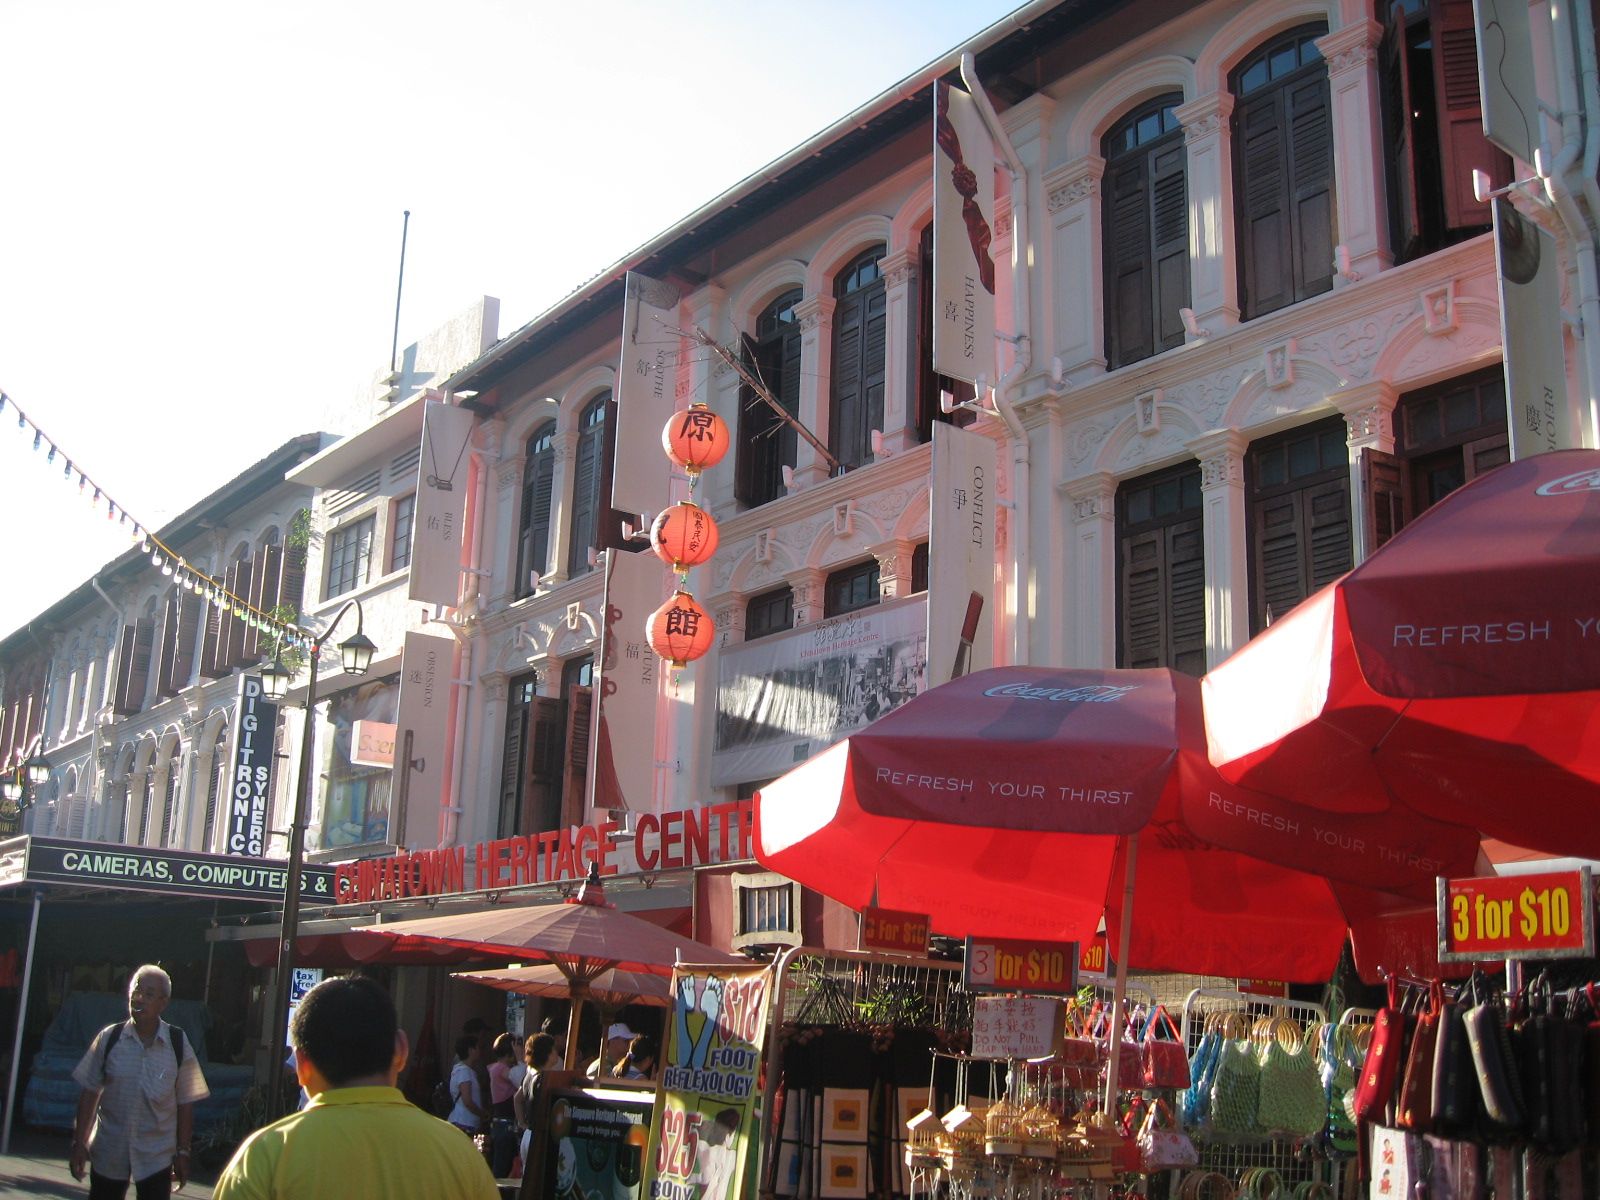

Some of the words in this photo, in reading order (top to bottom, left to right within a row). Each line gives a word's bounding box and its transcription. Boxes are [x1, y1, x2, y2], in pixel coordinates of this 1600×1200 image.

[964, 274, 975, 359] HAPPINESS
[654, 349, 665, 399] SOOTHE
[680, 410, 717, 442] 原
[972, 465, 984, 549] CONFLICT
[443, 512, 453, 541] BLESS
[665, 606, 701, 638] 館
[1393, 620, 1550, 647] REFRESH
[832, 639, 858, 651] Heritage
[858, 632, 881, 645] Centre
[423, 650, 437, 708] OBSESSION
[982, 682, 1142, 703] Coca-Cola
[231, 680, 261, 856] DIGITRONIC
[876, 767, 973, 793] REFRESH
[988, 781, 1045, 799] YOUR
[1059, 787, 1134, 805] THIRST
[248, 765, 268, 856] SYNERG
[1209, 791, 1300, 836] REFRESH
[1312, 827, 1366, 854] YOUR
[1377, 845, 1443, 873] THIRST
[62, 852, 174, 883] CAMERAS,
[314, 876, 328, 893] &
[334, 845, 465, 905] CHINATOWN
[475, 821, 618, 890] HERITAGE
[1452, 894, 1469, 942] 3
[1475, 893, 1514, 940] for
[1519, 886, 1570, 942] $10
[296, 970, 314, 981] tax
[972, 950, 989, 976] 3
[994, 949, 1024, 981] for
[1027, 948, 1064, 984] $10
[1084, 945, 1103, 969] $10
[719, 974, 765, 1045] $18
[975, 1034, 990, 1045] DO
[710, 1049, 758, 1071] FOOT
[663, 1066, 754, 1098] REFLEXOLOGY
[655, 1104, 702, 1181] $25
[651, 1179, 695, 1200] BODY
